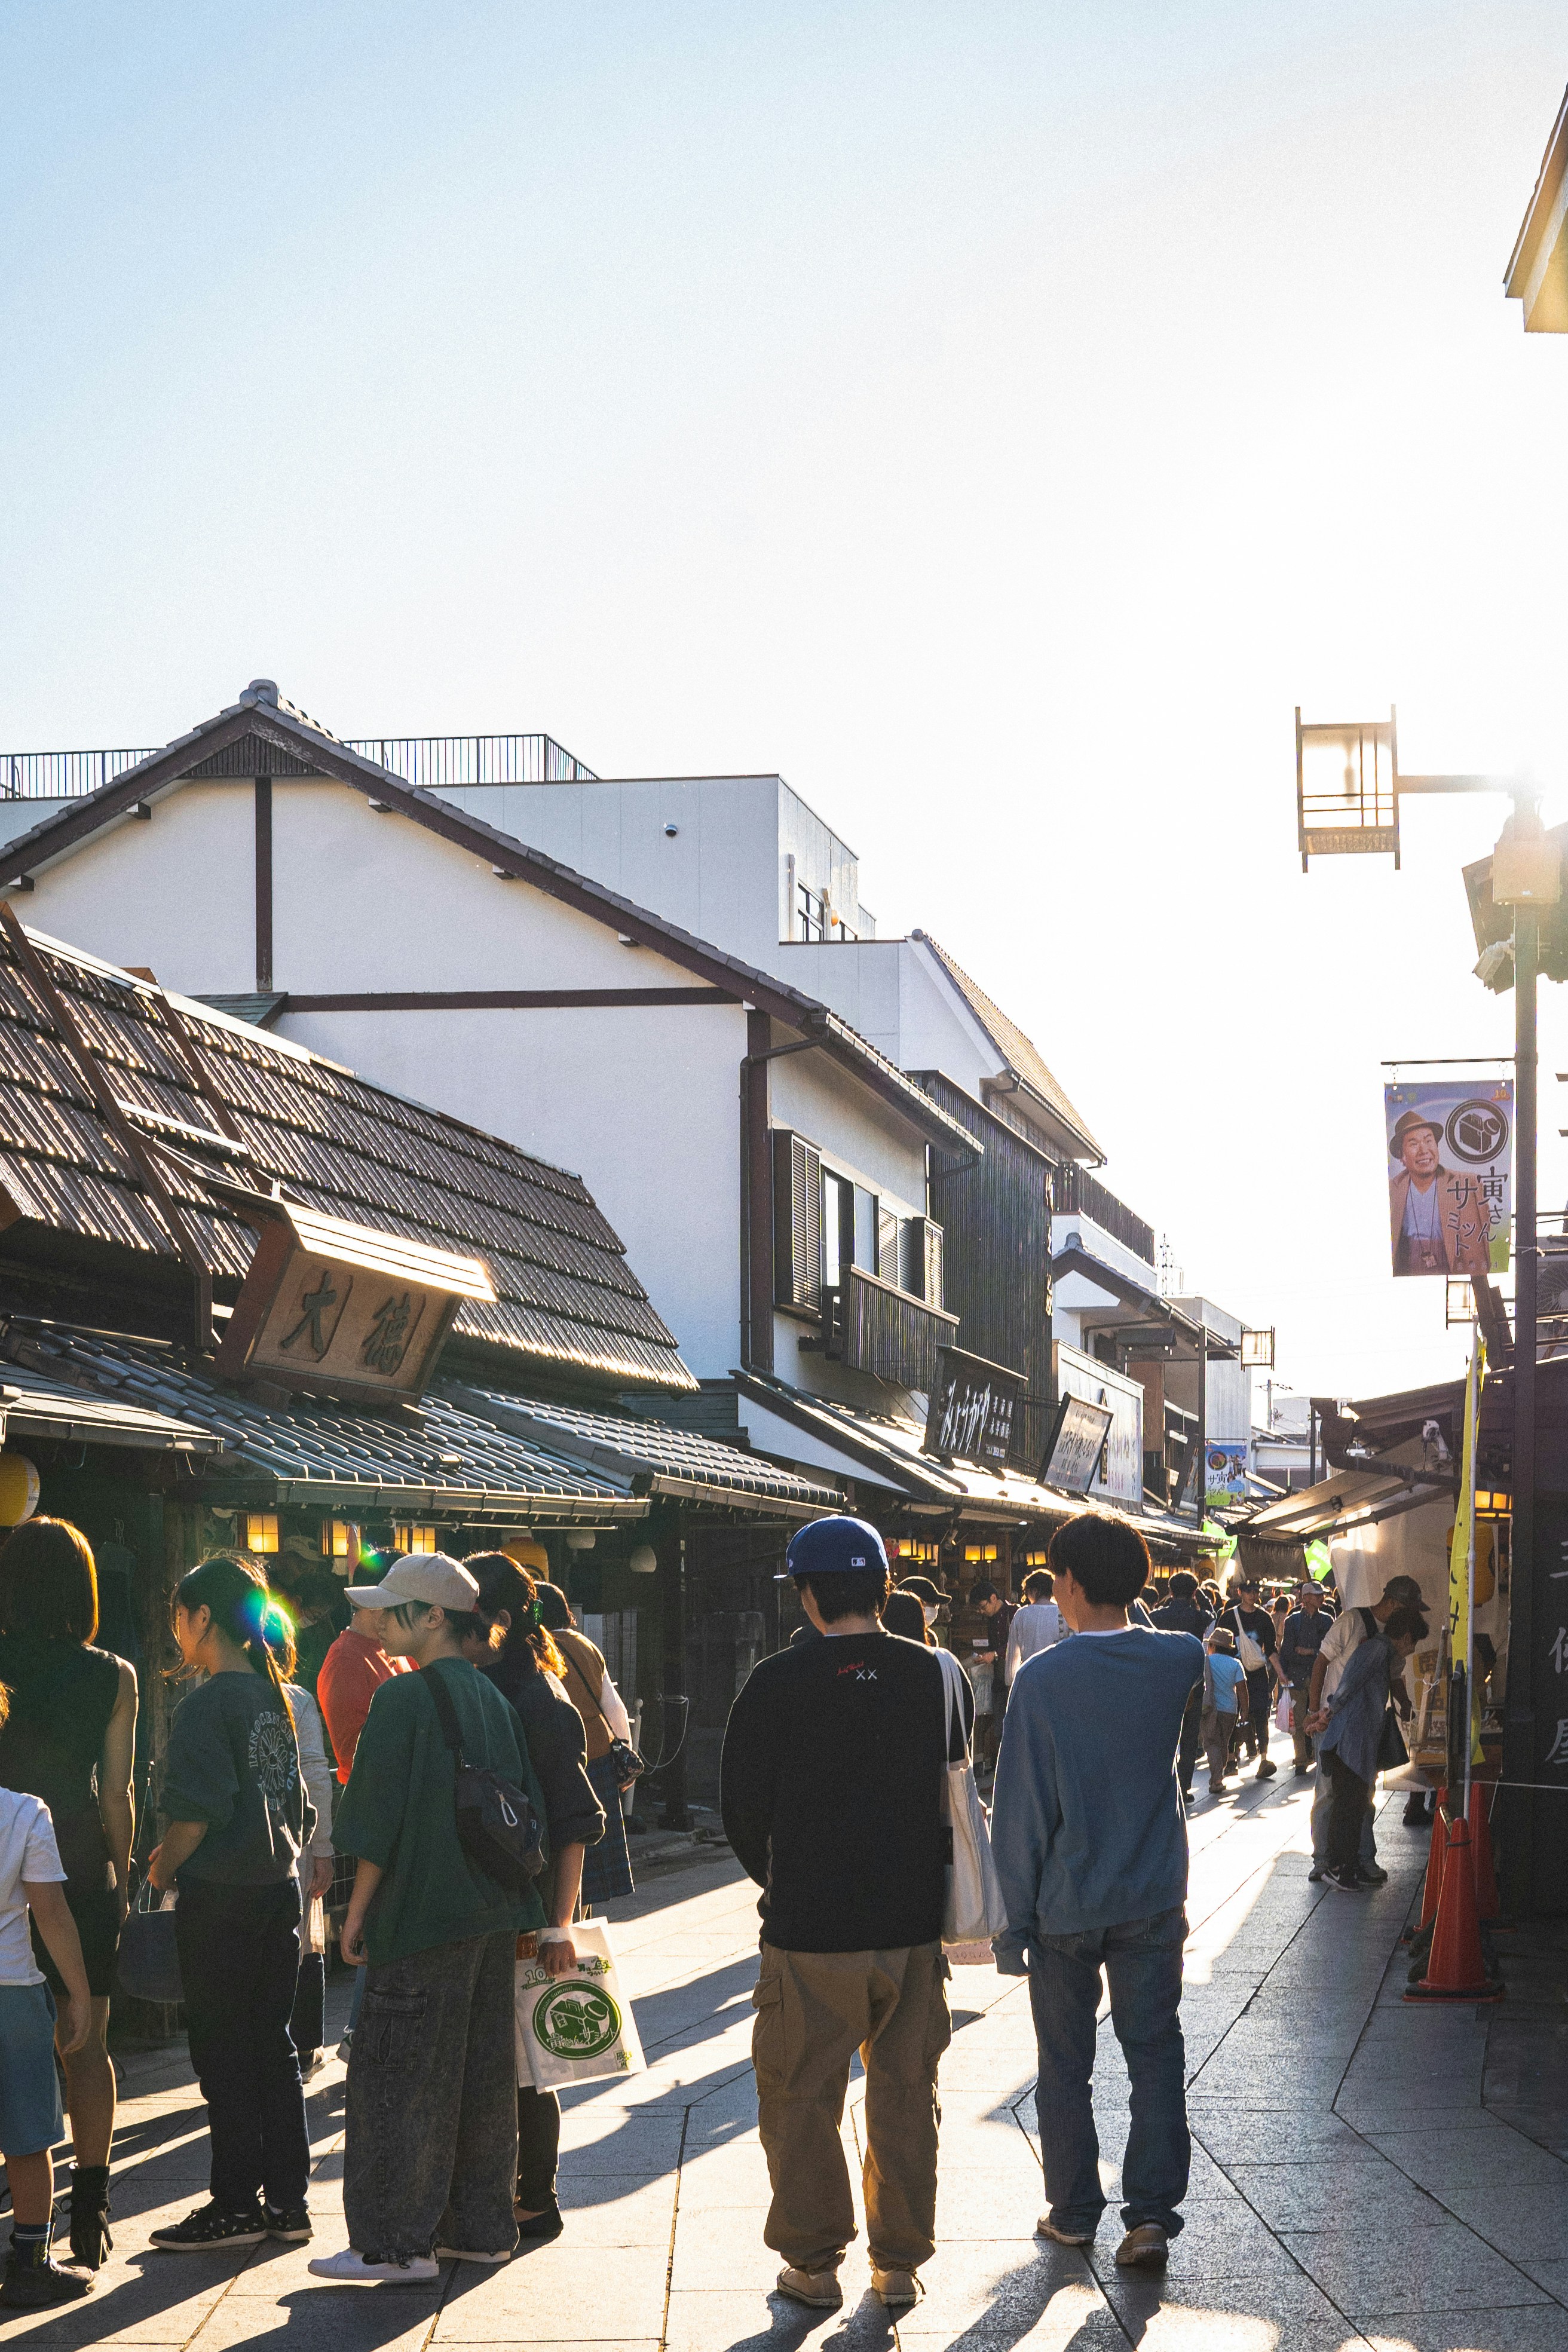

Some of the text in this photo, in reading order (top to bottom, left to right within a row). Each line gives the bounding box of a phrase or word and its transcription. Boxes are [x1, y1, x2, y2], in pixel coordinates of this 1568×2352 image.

[1447, 1178, 1478, 1256] サミット
[1477, 1166, 1508, 1243] 寅さん
[249, 1711, 294, 1768] INNOCENCE
[287, 1751, 298, 1791] AND
[550, 1986, 573, 1999] Summit
